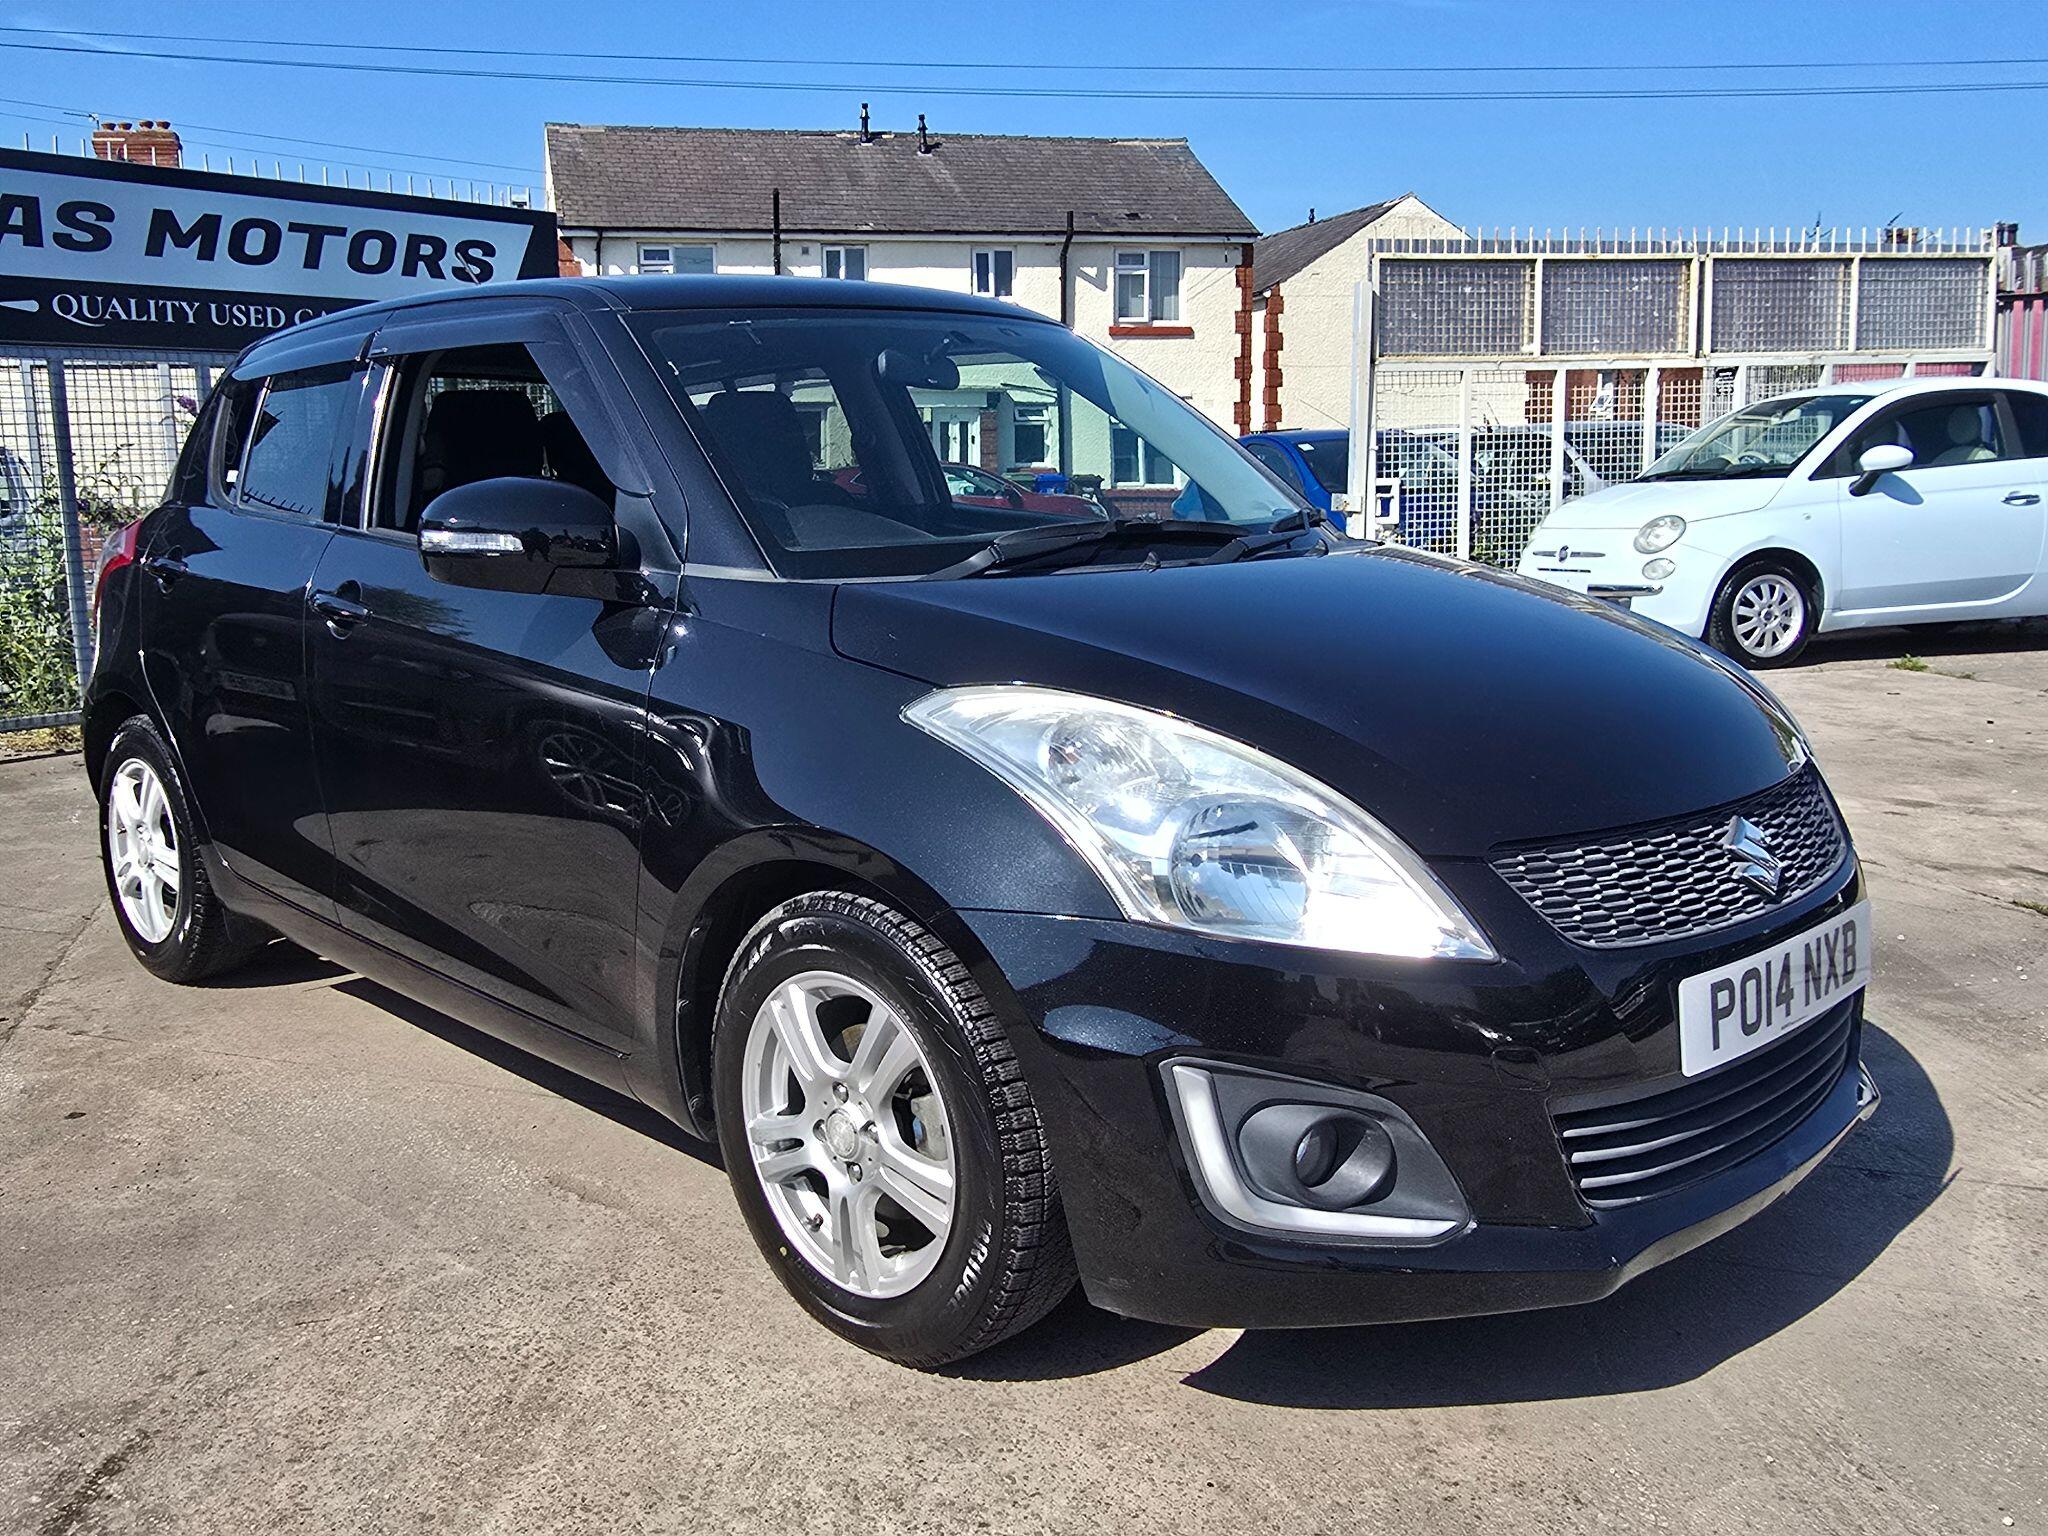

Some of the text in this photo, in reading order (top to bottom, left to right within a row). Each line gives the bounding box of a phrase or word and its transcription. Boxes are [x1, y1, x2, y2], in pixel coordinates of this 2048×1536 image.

[0, 193, 497, 284] AS MOTORS
[52, 293, 200, 327] QUALITY
[208, 302, 286, 329] USED
[1710, 919, 1857, 1051] PO14 NXB
